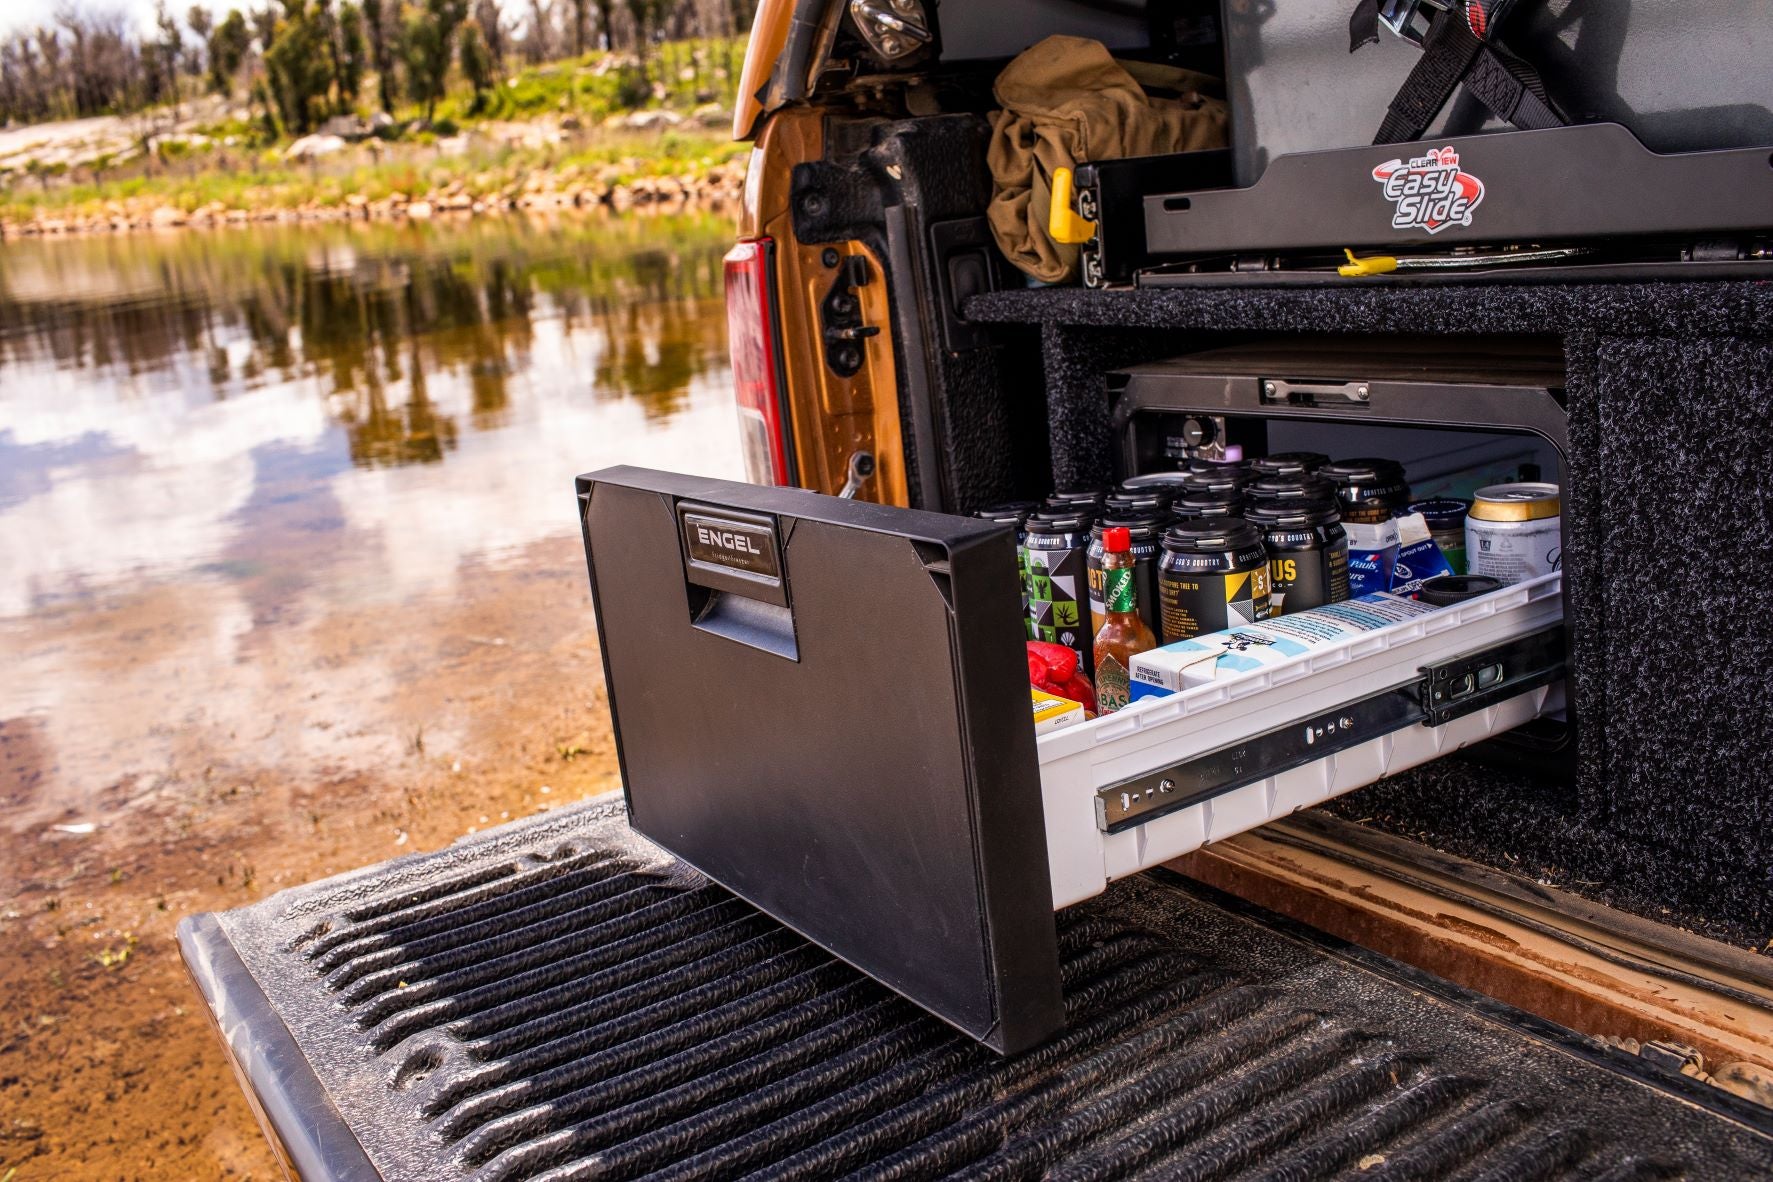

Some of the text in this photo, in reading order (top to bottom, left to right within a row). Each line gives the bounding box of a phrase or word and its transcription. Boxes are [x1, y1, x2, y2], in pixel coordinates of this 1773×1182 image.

[1387, 168, 1457, 199] Easy
[1395, 193, 1467, 224] Slide
[697, 526, 760, 555] ENGEL
[1271, 559, 1297, 581] US
[1106, 570, 1132, 611] SMOKED
[1135, 672, 1164, 686] AFTER OPENING
[1136, 665, 1161, 679] REFRIGERATE
